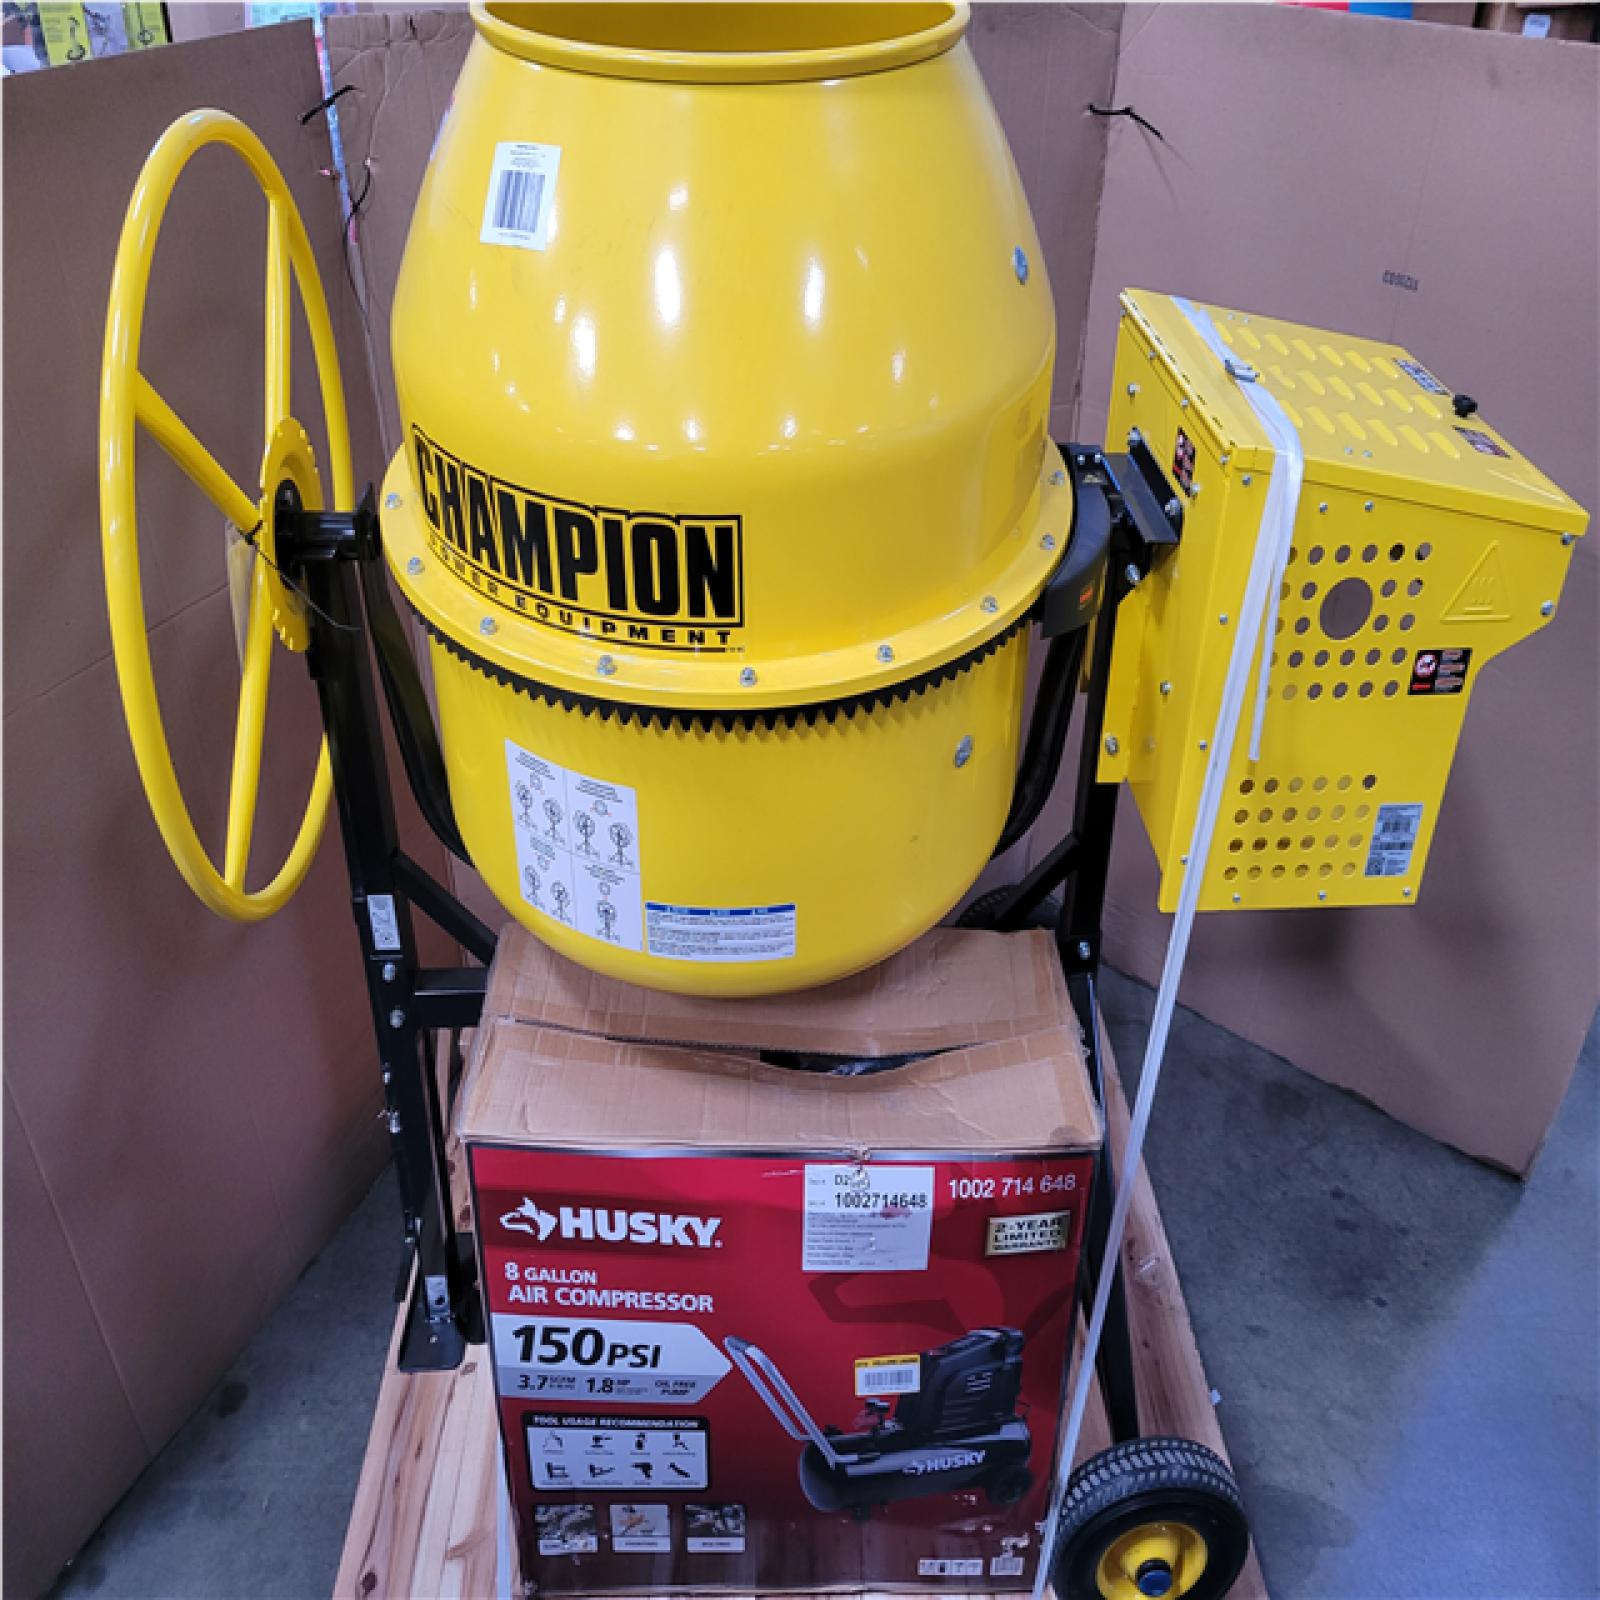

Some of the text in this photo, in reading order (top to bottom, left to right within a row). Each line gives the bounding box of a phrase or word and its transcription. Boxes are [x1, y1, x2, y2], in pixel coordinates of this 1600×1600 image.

[414, 434, 737, 618] CHAMPION
[515, 594, 731, 645] EQUIPMENT
[949, 1174, 1077, 1199] 1002 714 648
[834, 1191, 928, 1209] 1002714648
[559, 1206, 722, 1248] HUSKY
[504, 1262, 598, 1285] 8 GALLON
[508, 1285, 715, 1313] AIR COMPRESSOR
[517, 1374, 548, 1391] 3.7
[585, 1377, 614, 1394] 1.8
[926, 1450, 986, 1473] HUSKY
